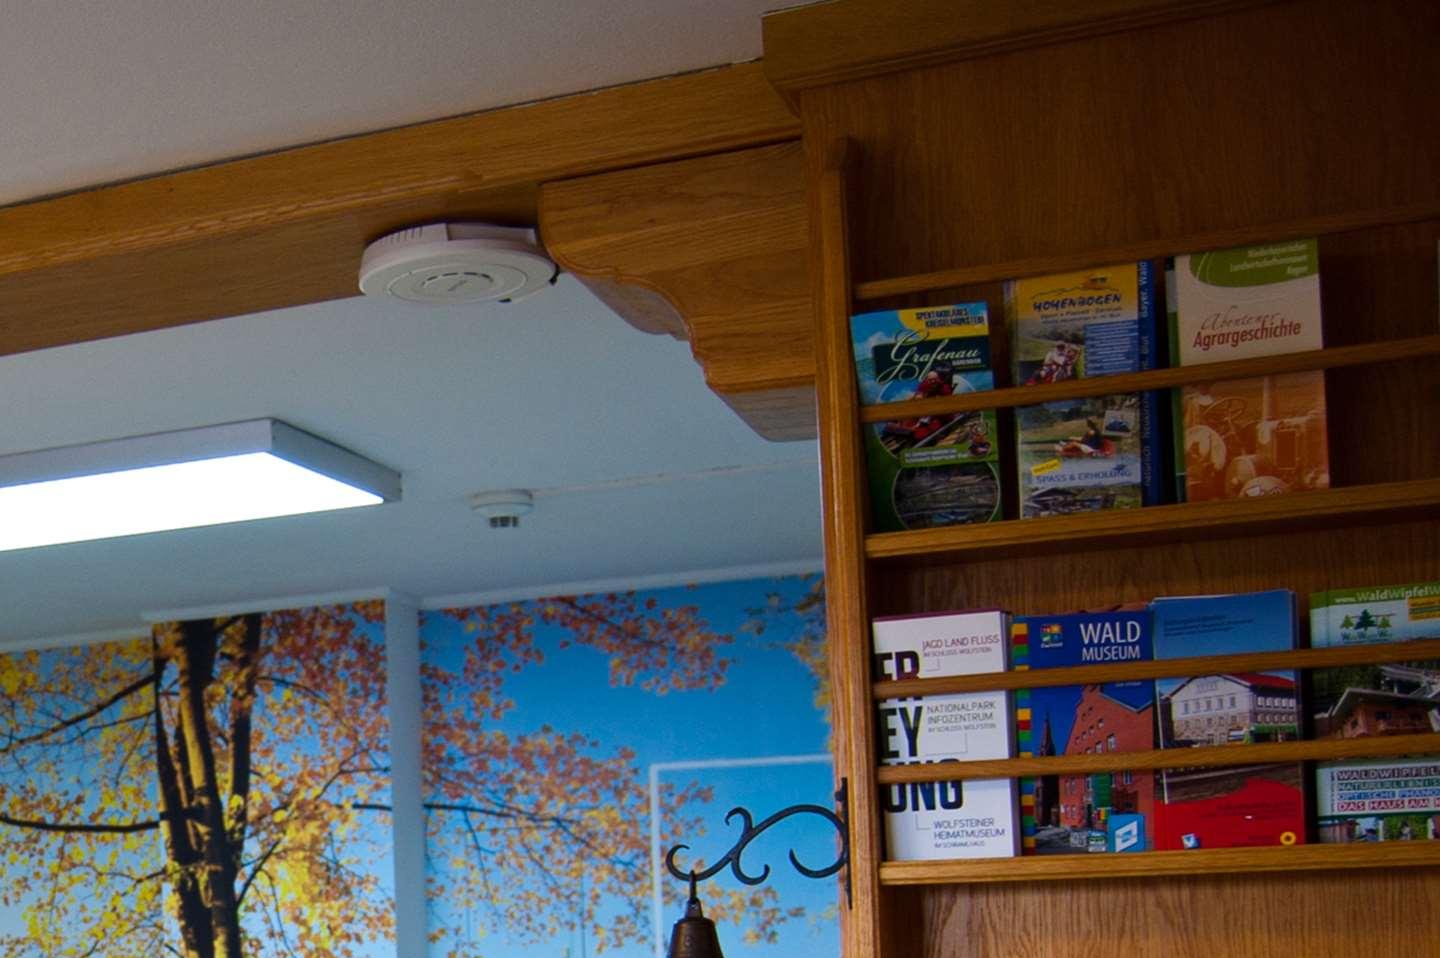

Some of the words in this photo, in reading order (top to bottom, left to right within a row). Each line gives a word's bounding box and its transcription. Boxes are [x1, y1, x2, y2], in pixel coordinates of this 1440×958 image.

[1032, 293, 1122, 312] HOHENBOGEN
[1192, 319, 1302, 351] Agrargeschichte
[878, 331, 983, 384] Grafenau
[1036, 473, 1067, 484] SPASS
[1334, 585, 1440, 604] www.WaldWipfelW
[1079, 620, 1141, 645] WALD
[922, 639, 945, 651] JAGD
[945, 637, 969, 648] LAND
[971, 634, 1000, 645] FLUSS
[1081, 645, 1141, 662] MUSEUM
[927, 699, 996, 714] NATIONALPARK
[927, 712, 994, 725] INFOZENTRUM
[880, 705, 923, 758] EY
[1337, 765, 1440, 782] WALDWIPFEL
[1337, 800, 1365, 813] DAS
[1368, 798, 1405, 810] HAUS
[934, 817, 995, 831] WOLFSTEINER
[934, 828, 1006, 842] HEIMATMUSEUM
